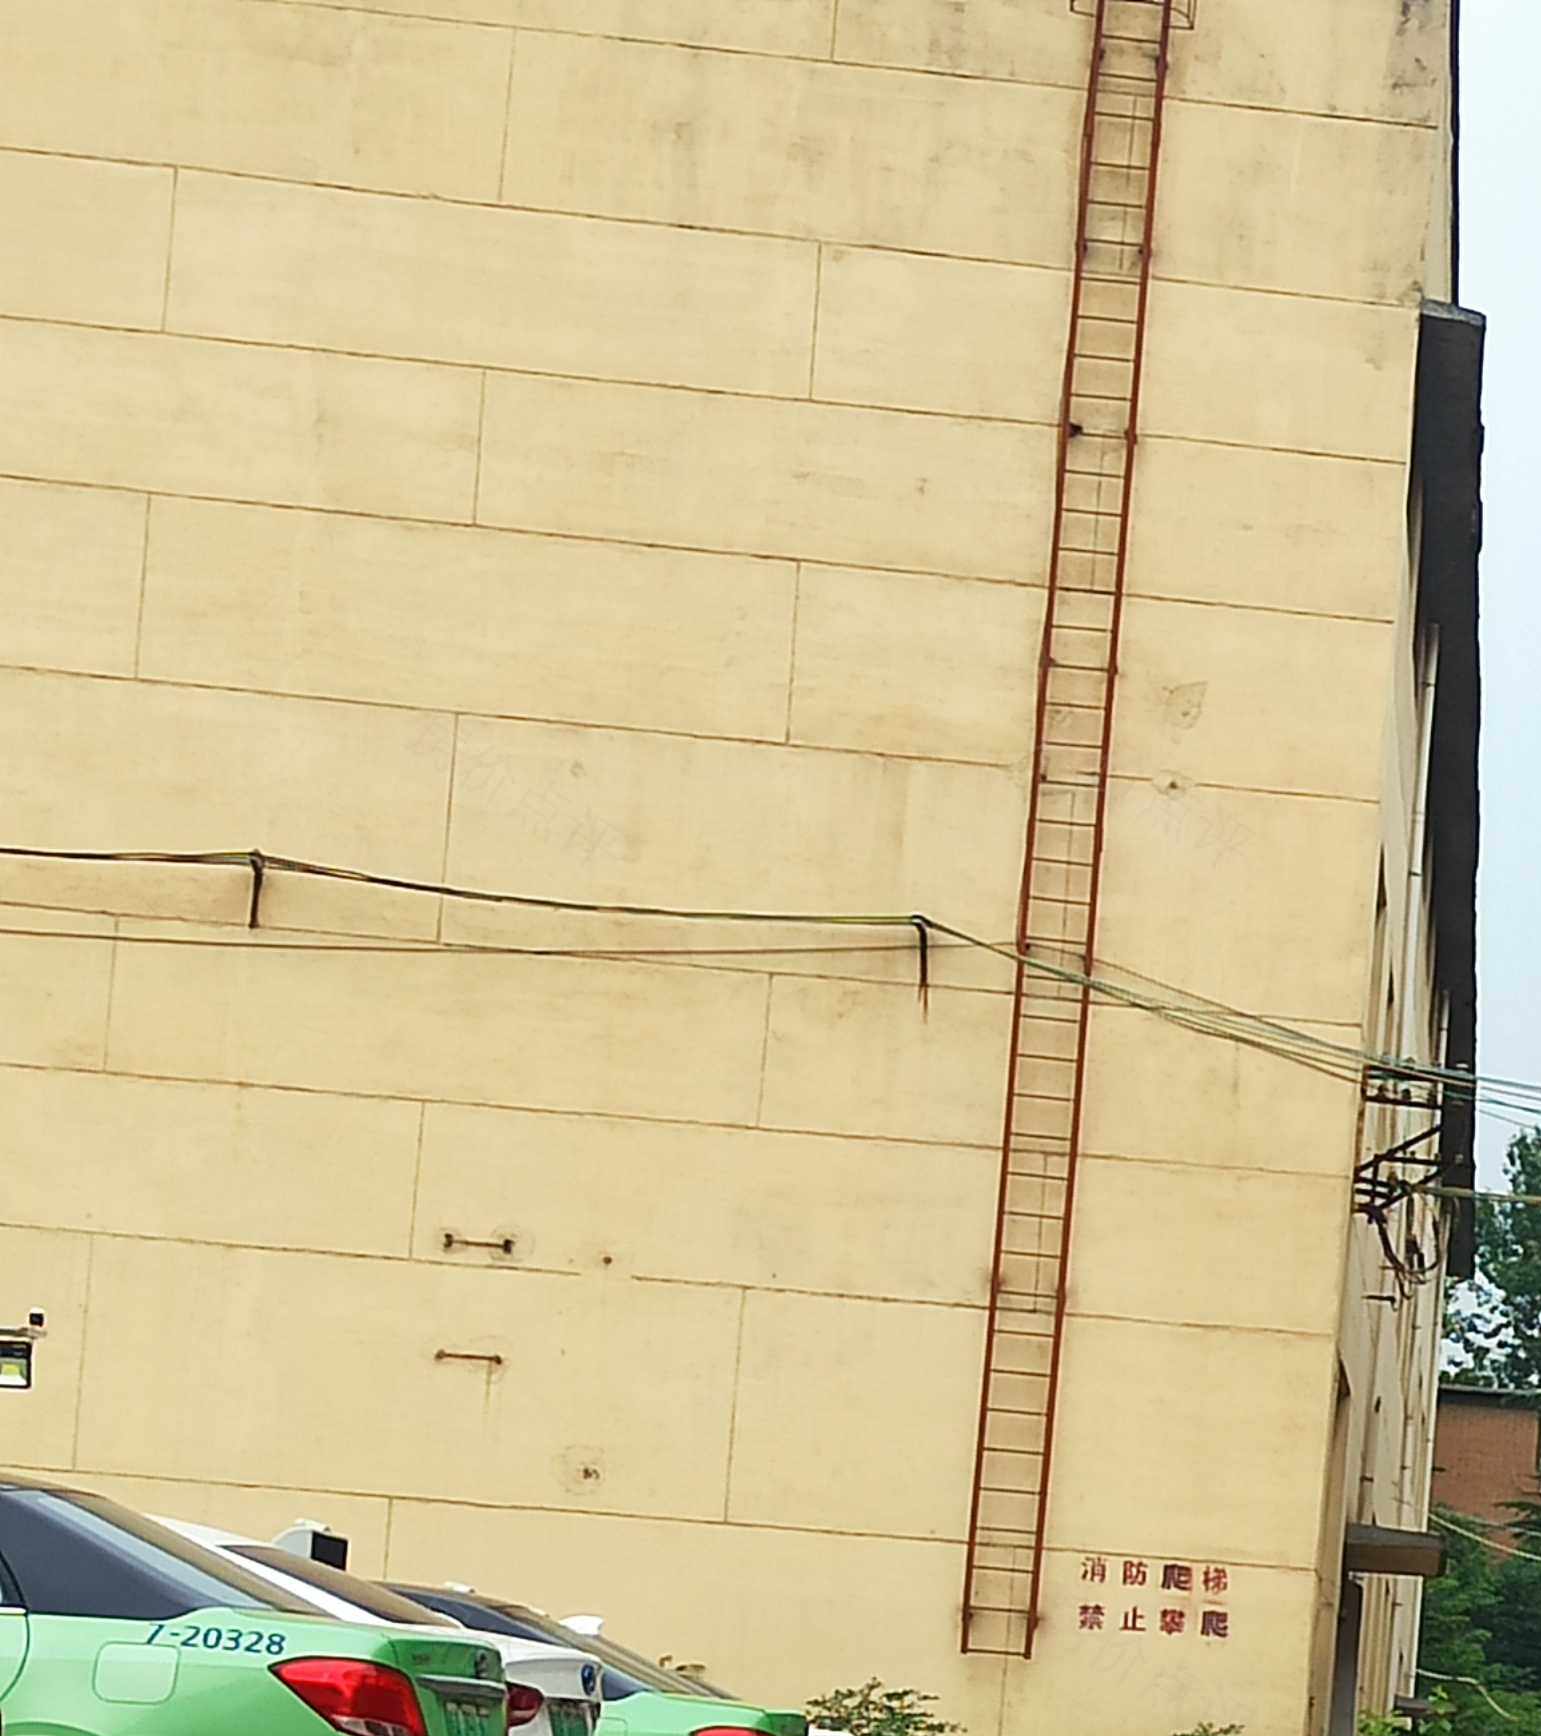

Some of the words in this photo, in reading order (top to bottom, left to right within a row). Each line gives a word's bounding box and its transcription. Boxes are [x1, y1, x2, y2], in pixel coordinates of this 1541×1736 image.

[1080, 1556, 1228, 1595] 消防爬梯
[1078, 1604, 1229, 1638] 禁止攀爬
